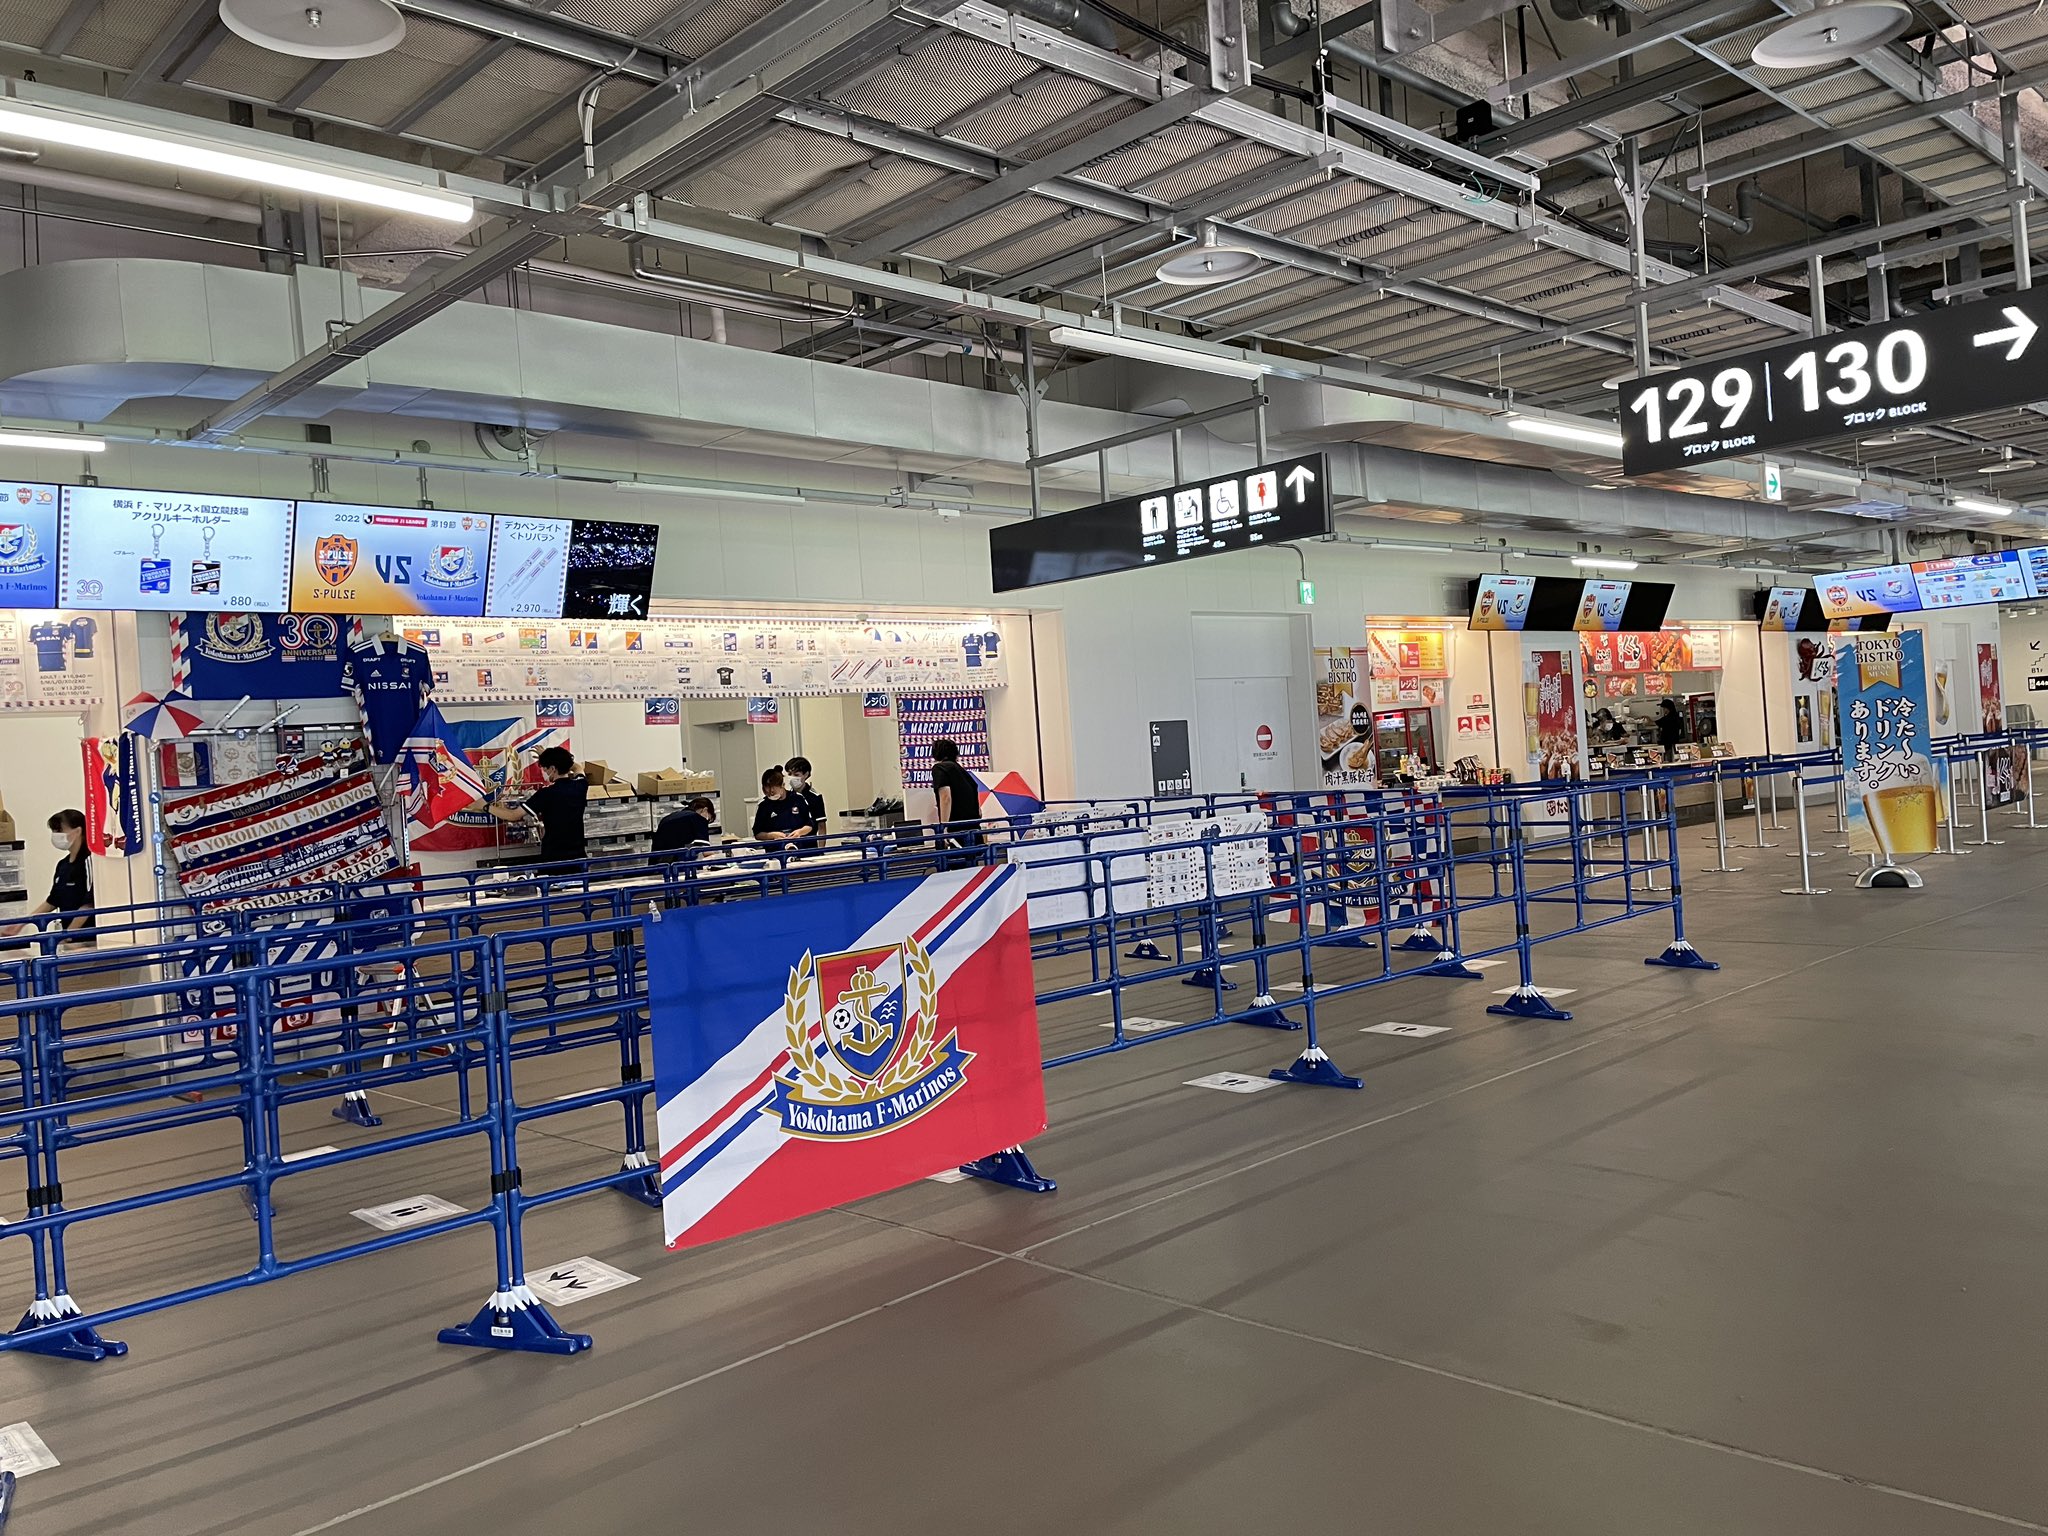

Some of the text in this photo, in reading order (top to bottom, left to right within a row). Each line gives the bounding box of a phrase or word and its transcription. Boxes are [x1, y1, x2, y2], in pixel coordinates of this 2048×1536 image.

[1630, 329, 1928, 444] 129 130
[1843, 401, 1927, 426] ブロック BLOCK
[1683, 437, 1756, 456] ブロック BLOCK
[132, 512, 231, 525] アクリルキーホルダー
[334, 514, 360, 523] 2022
[430, 520, 457, 528] 第19節
[504, 521, 562, 532] デカペンライト
[318, 550, 353, 560] S-PULSE
[375, 554, 412, 584] VS
[313, 589, 356, 600] S-PULSE
[1856, 588, 1877, 602] VS
[608, 593, 643, 615] 輝く
[1856, 638, 1901, 651] TOKYO
[204, 647, 236, 659] Yokohama
[1856, 650, 1904, 663] BISTRO
[1328, 657, 1355, 670] TOKYO
[1328, 670, 1357, 684] BISTRO
[911, 700, 948, 711] TAKUYA
[952, 699, 974, 709] KIDA
[910, 721, 984, 733] MARCOS JUNIOR 10
[1850, 700, 1879, 789] あります。
[1875, 698, 1897, 780] ドリンク
[1325, 769, 1374, 786] 肉汁黒豚餃子
[230, 799, 272, 818] Yokohama
[203, 818, 290, 851] YOKOHAMA
[319, 848, 390, 884] MARINOS
[788, 1103, 872, 1132] Yokohama
